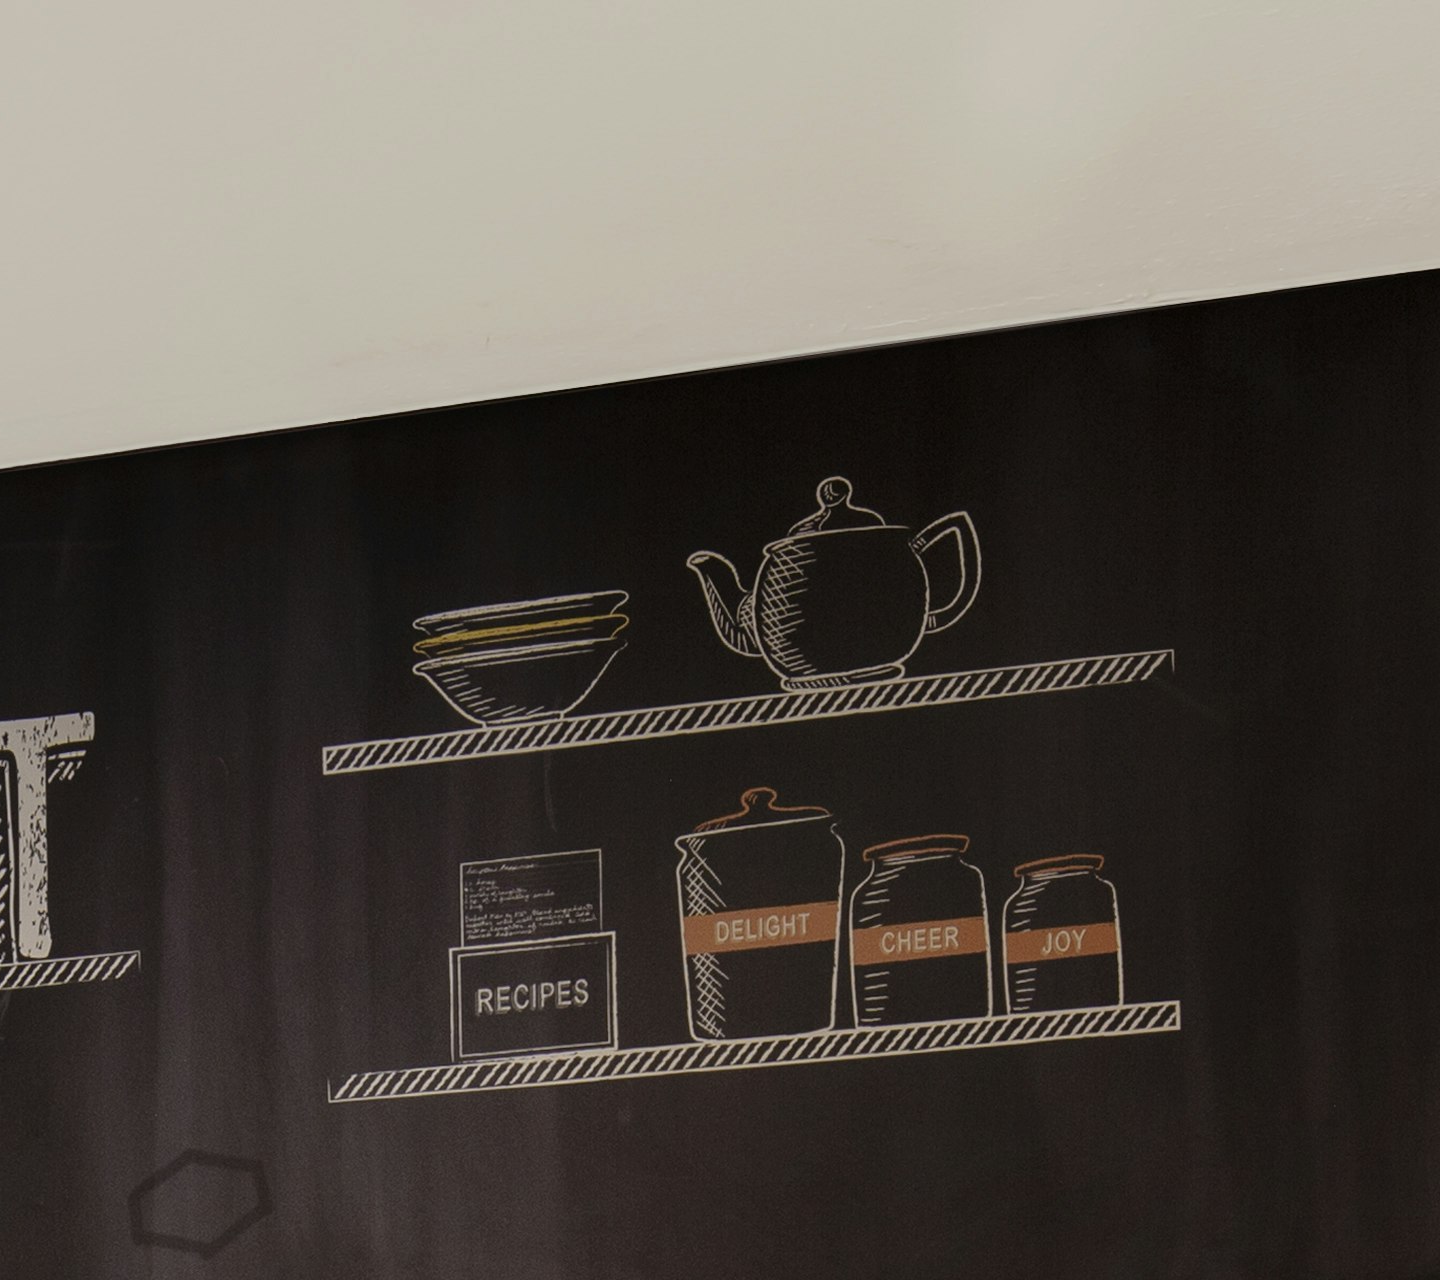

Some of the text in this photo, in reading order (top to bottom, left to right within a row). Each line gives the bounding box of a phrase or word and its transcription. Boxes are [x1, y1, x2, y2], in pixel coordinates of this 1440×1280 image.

[714, 912, 810, 943] DELIGHT
[880, 926, 959, 954] CHEER
[1041, 928, 1087, 956] JOY
[476, 978, 589, 1016] RECIPES
